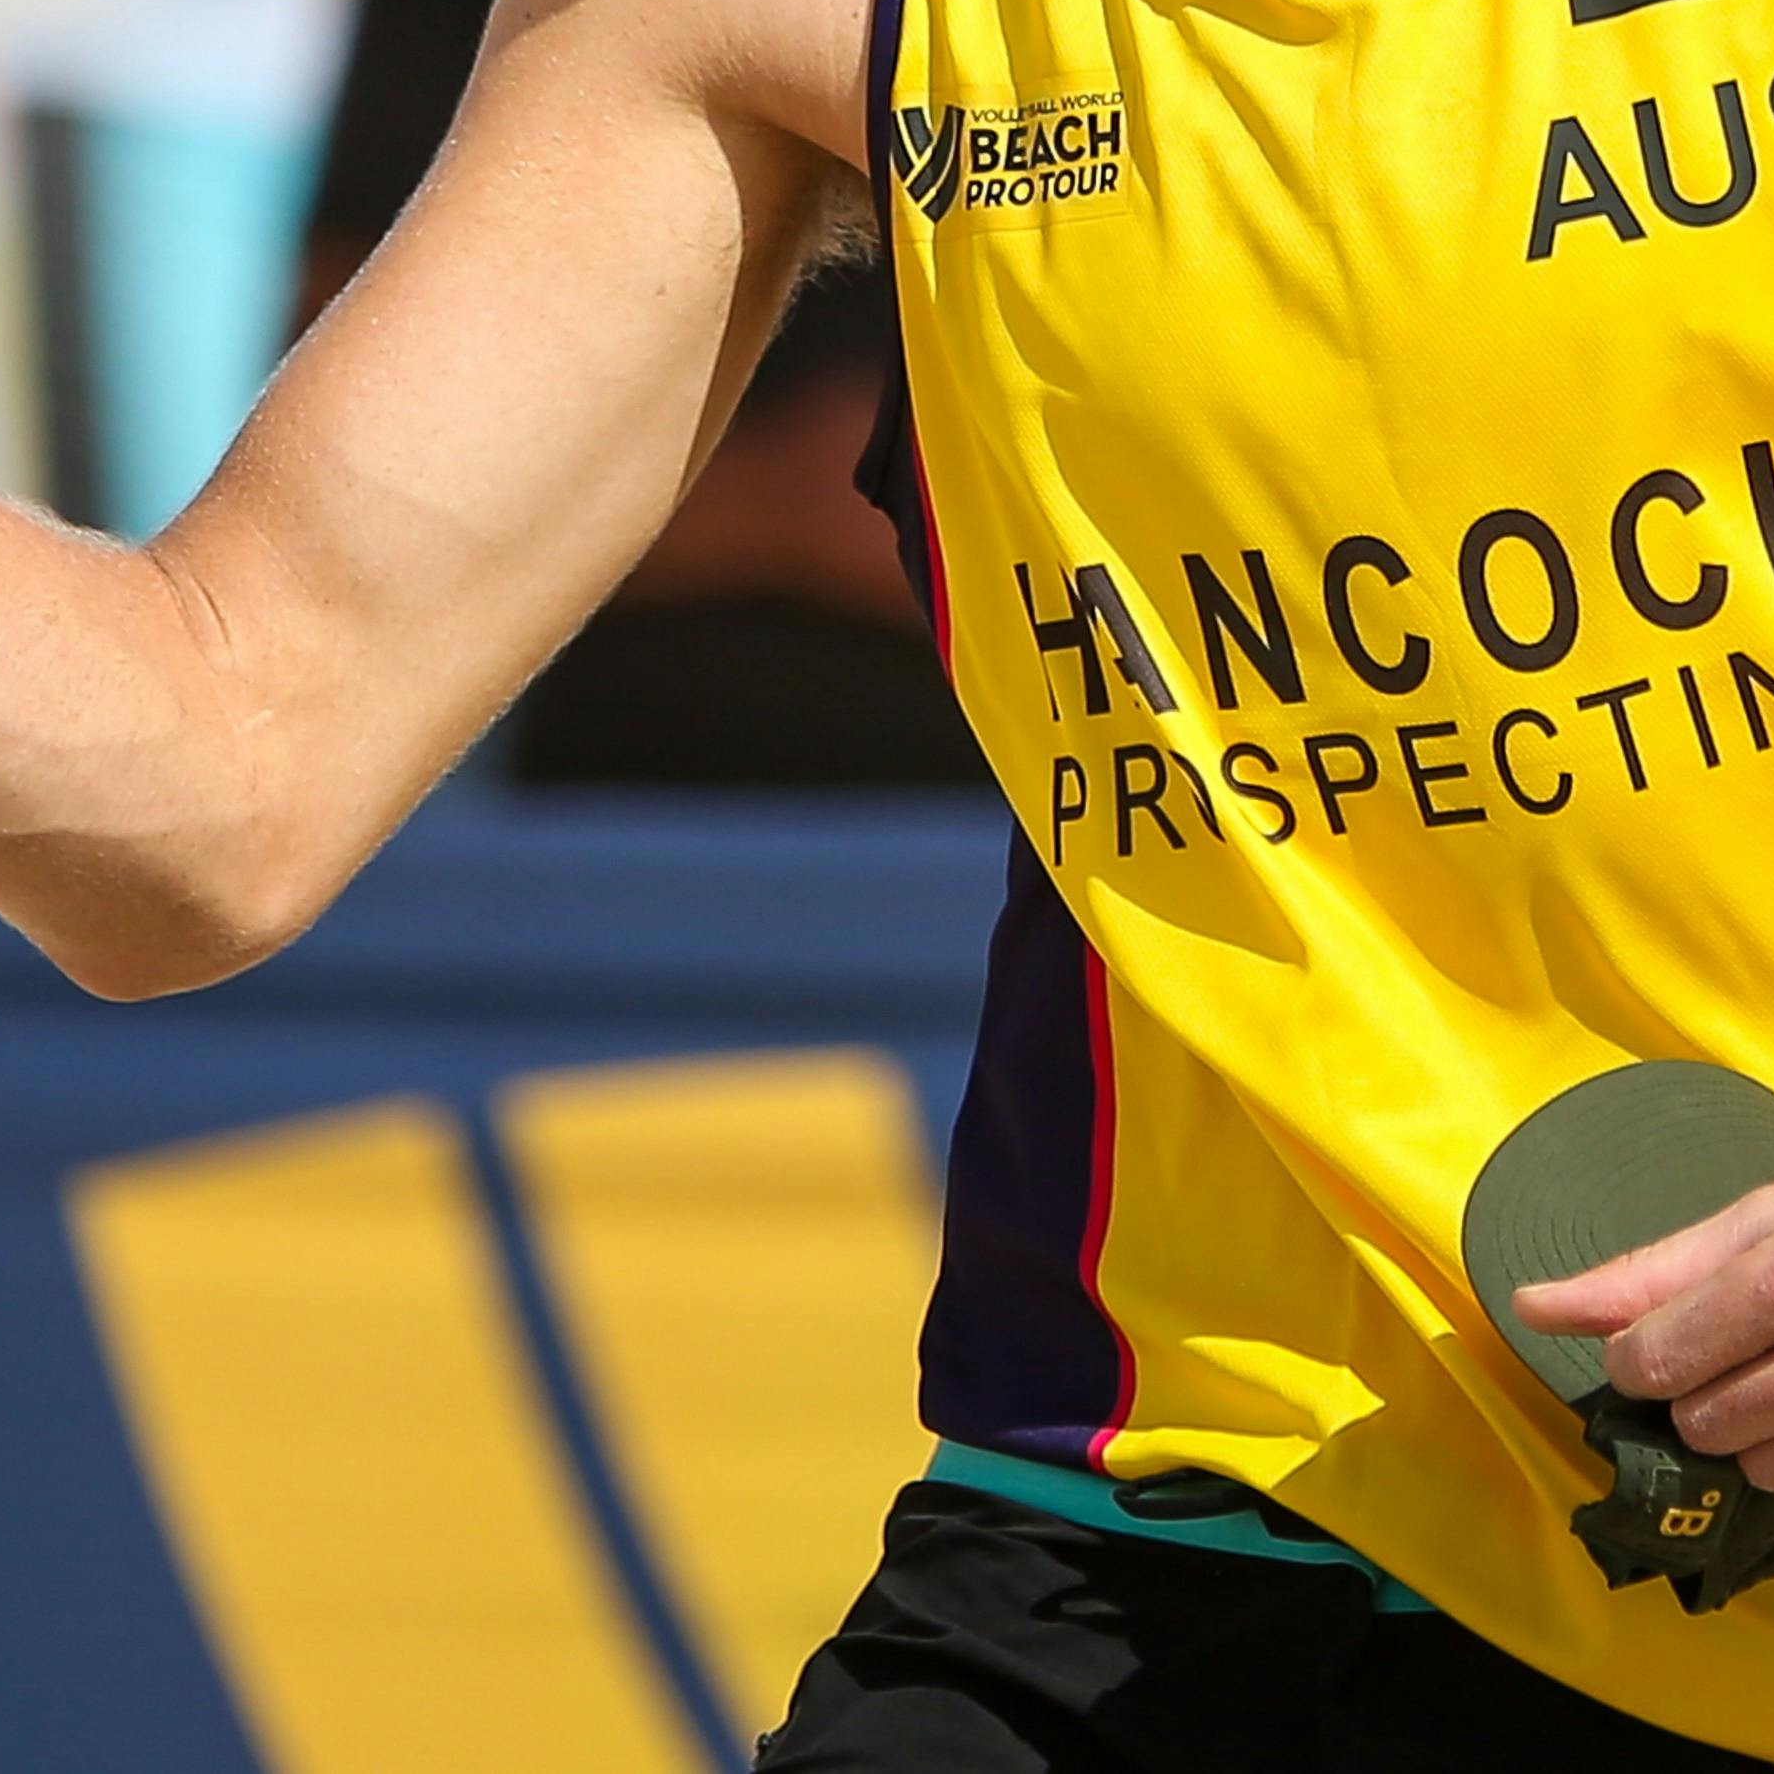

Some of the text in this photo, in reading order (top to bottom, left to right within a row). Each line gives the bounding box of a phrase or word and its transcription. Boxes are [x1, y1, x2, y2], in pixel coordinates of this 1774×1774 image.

[970, 92, 1124, 123] VOLLEBALL WORLD
[970, 110, 1121, 174] BEACH
